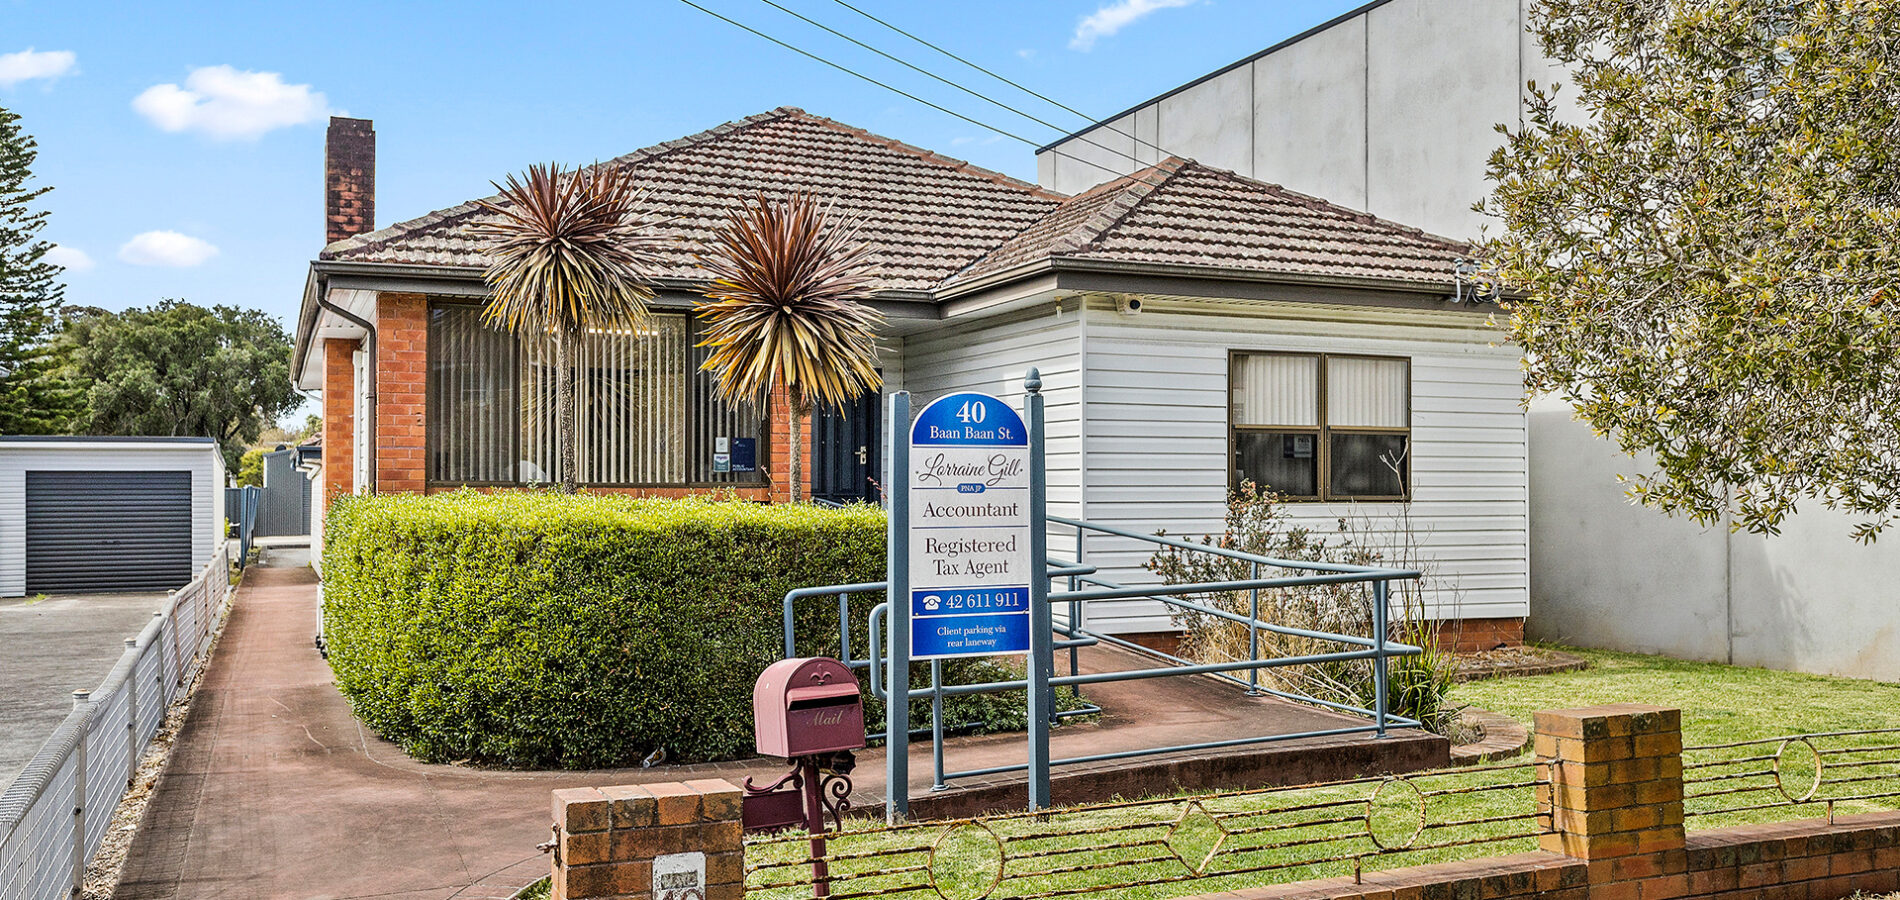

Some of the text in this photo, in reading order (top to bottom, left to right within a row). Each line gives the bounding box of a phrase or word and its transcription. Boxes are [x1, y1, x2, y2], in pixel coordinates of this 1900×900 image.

[956, 400, 986, 423] 40
[930, 426, 1014, 440] Baan Baan St.
[918, 453, 1021, 486] Lorraine Gill
[922, 502, 1018, 517] Accountant
[925, 535, 1016, 558] Registered
[933, 559, 1009, 578] Tax Agent
[946, 592, 1019, 609] 42 611 911
[937, 624, 1006, 637] Client parking via
[947, 637, 997, 648] rear laneway
[807, 710, 843, 726] Mail
